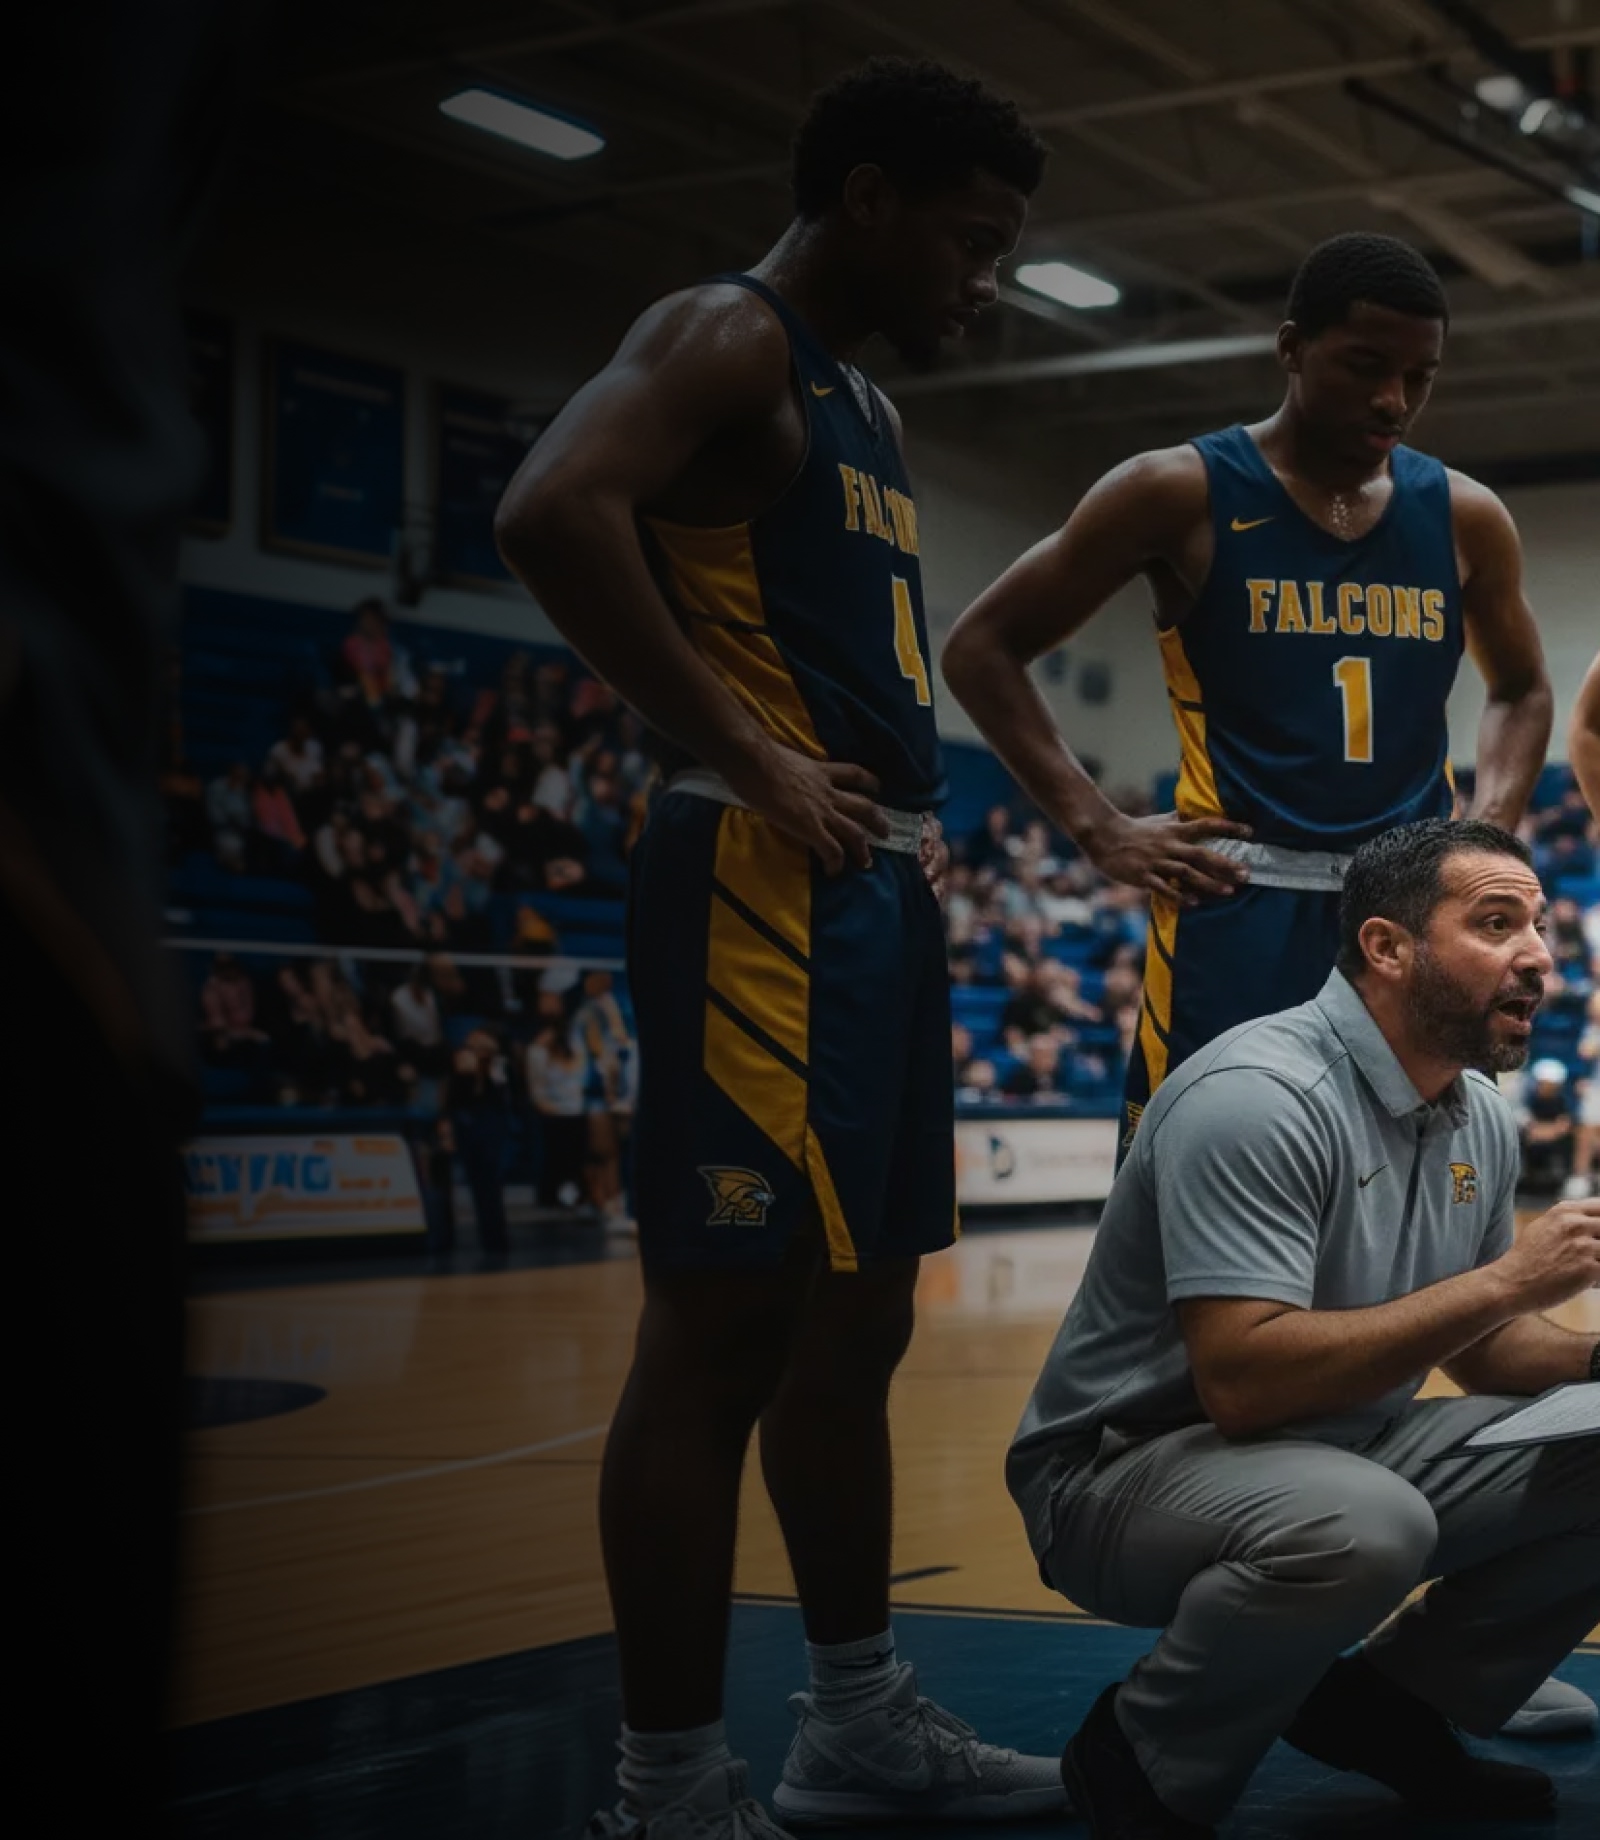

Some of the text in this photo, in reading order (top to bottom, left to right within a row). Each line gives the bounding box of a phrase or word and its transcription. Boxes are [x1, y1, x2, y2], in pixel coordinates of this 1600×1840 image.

[891, 572, 931, 706] 4
[1246, 578, 1446, 642] FALCONS
[1332, 655, 1374, 763] 1
